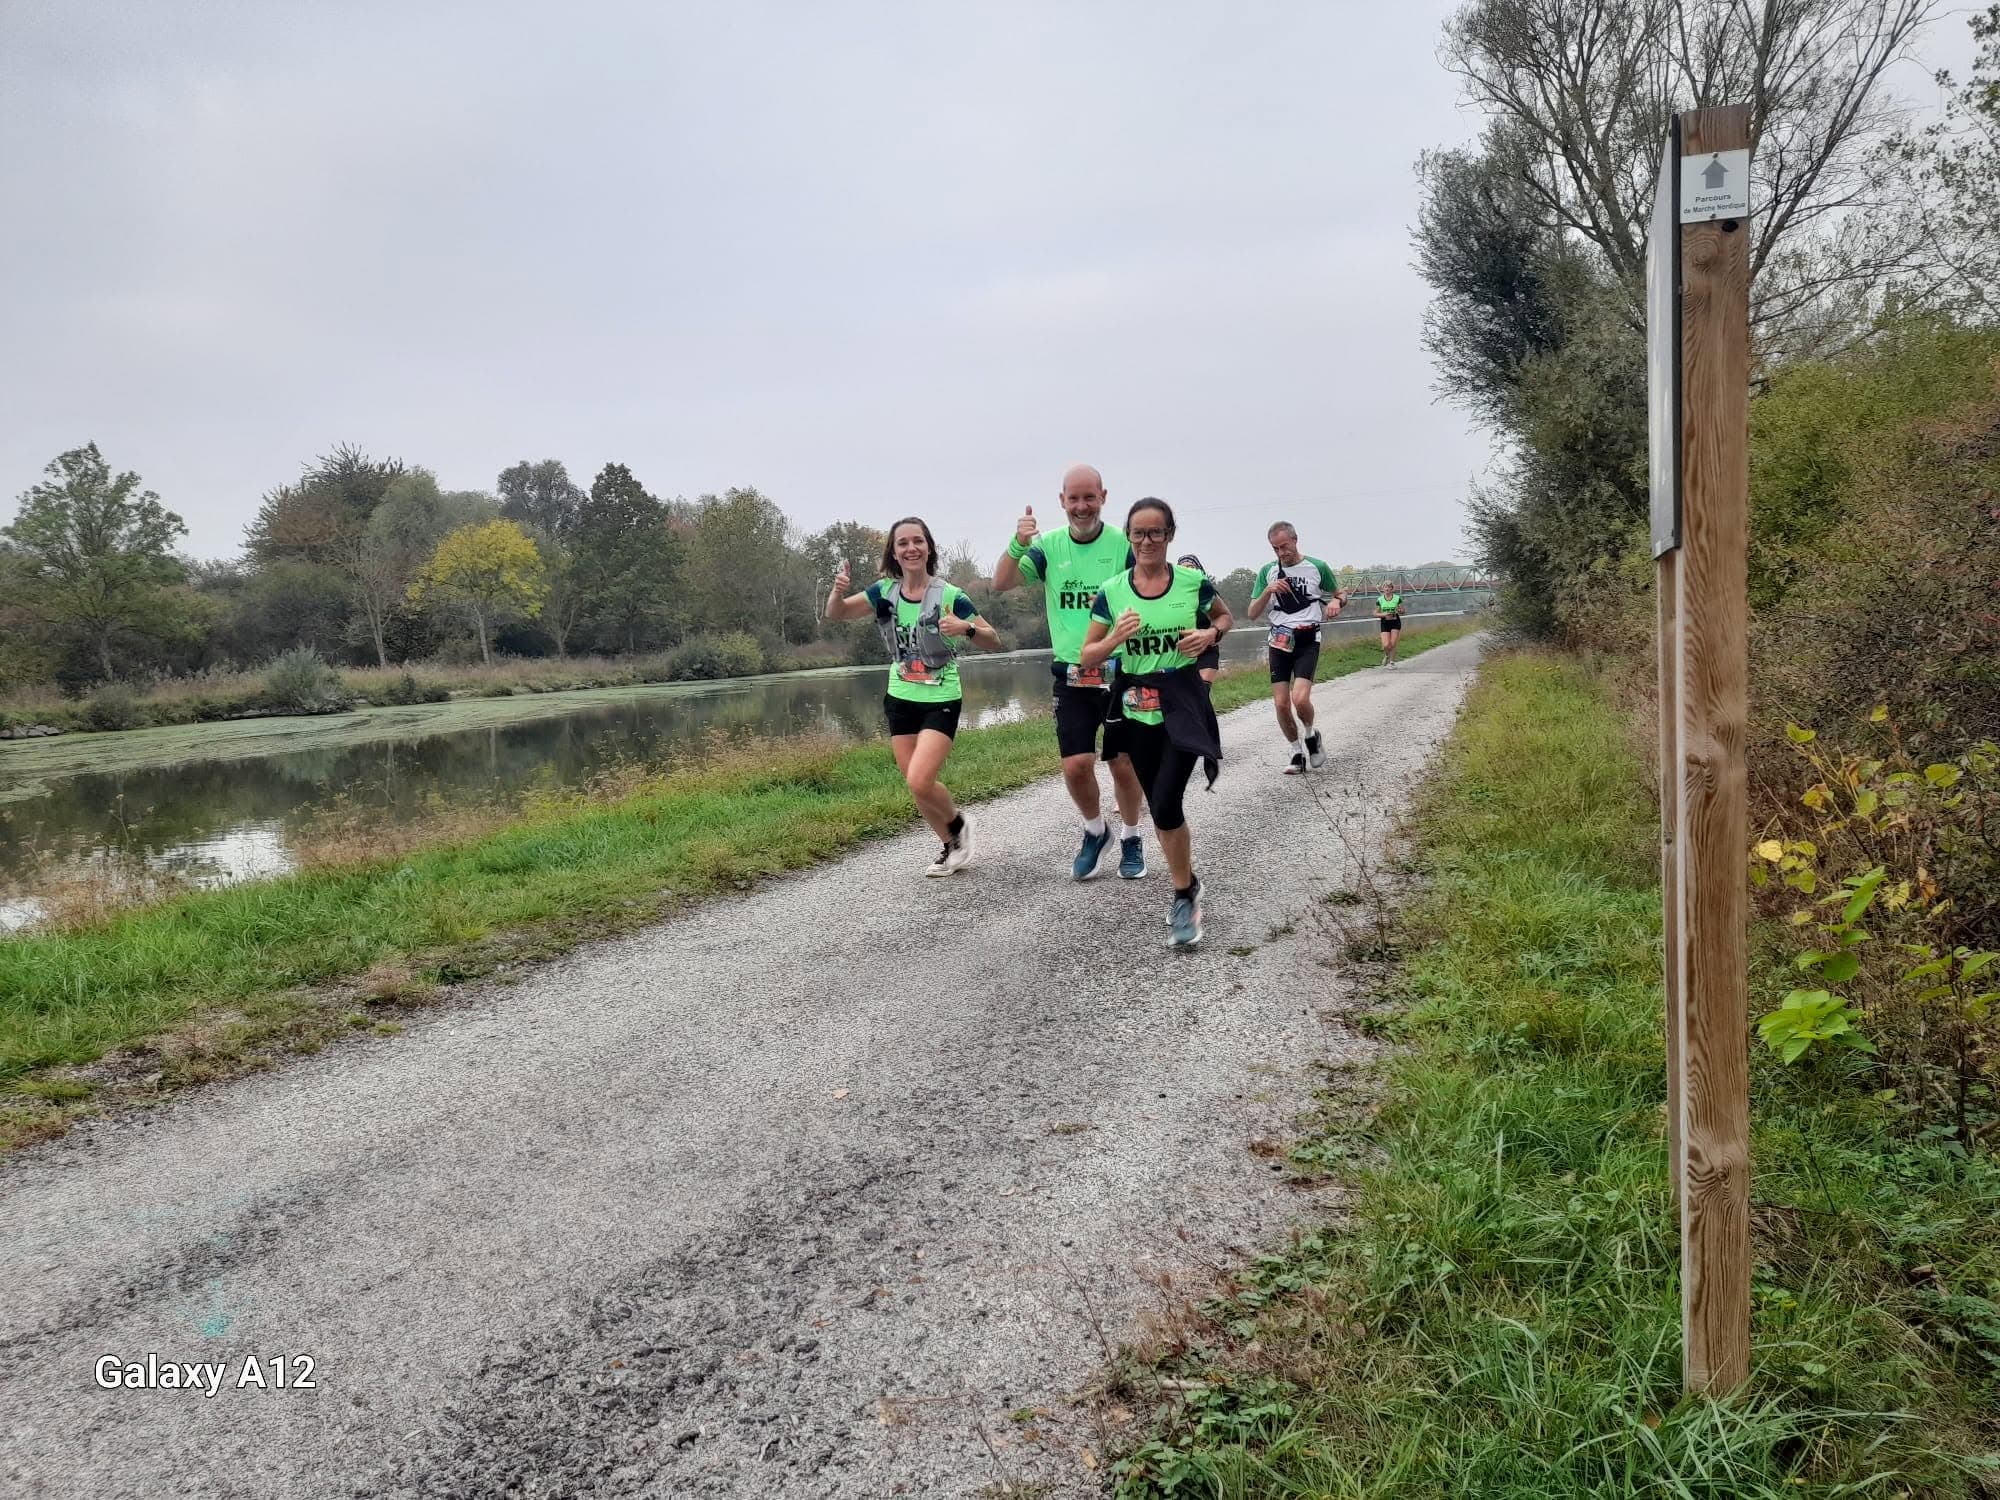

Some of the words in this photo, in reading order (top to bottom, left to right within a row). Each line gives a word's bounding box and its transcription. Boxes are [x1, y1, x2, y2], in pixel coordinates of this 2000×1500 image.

[1695, 194, 1731, 203] Parcours
[1717, 202, 1746, 210] Nordique
[1060, 591, 1098, 609] RR
